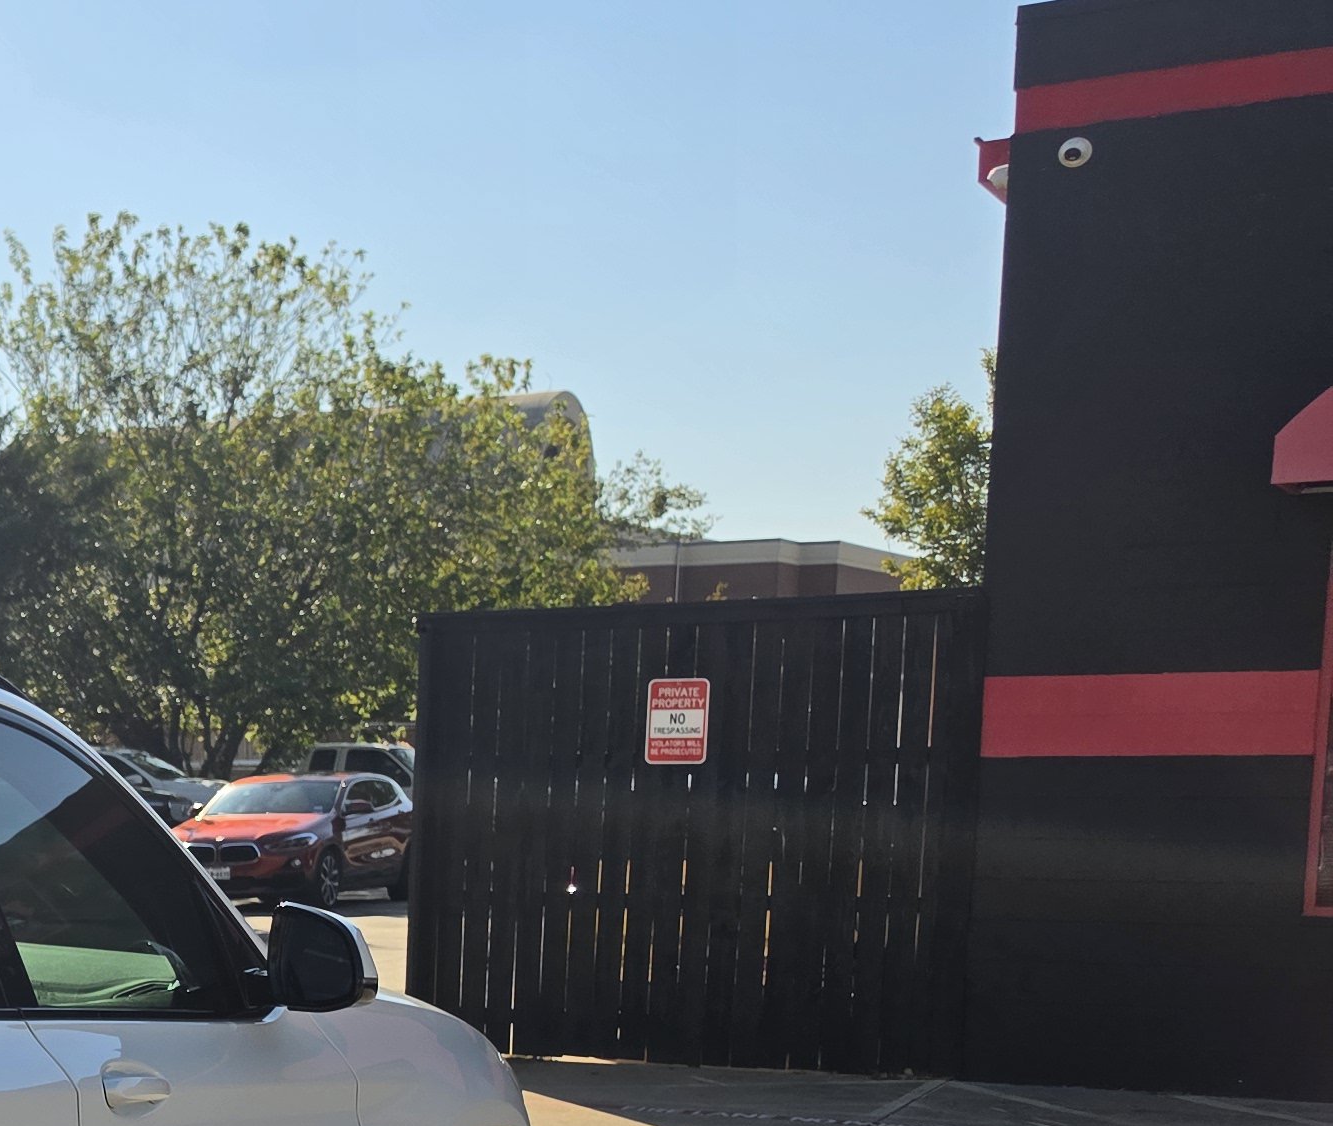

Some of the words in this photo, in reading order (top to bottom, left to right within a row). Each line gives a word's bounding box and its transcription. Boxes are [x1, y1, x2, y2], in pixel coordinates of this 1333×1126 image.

[659, 687, 700, 697] PRIVATE
[652, 698, 705, 708] PROPERTY
[669, 713, 686, 725] NO
